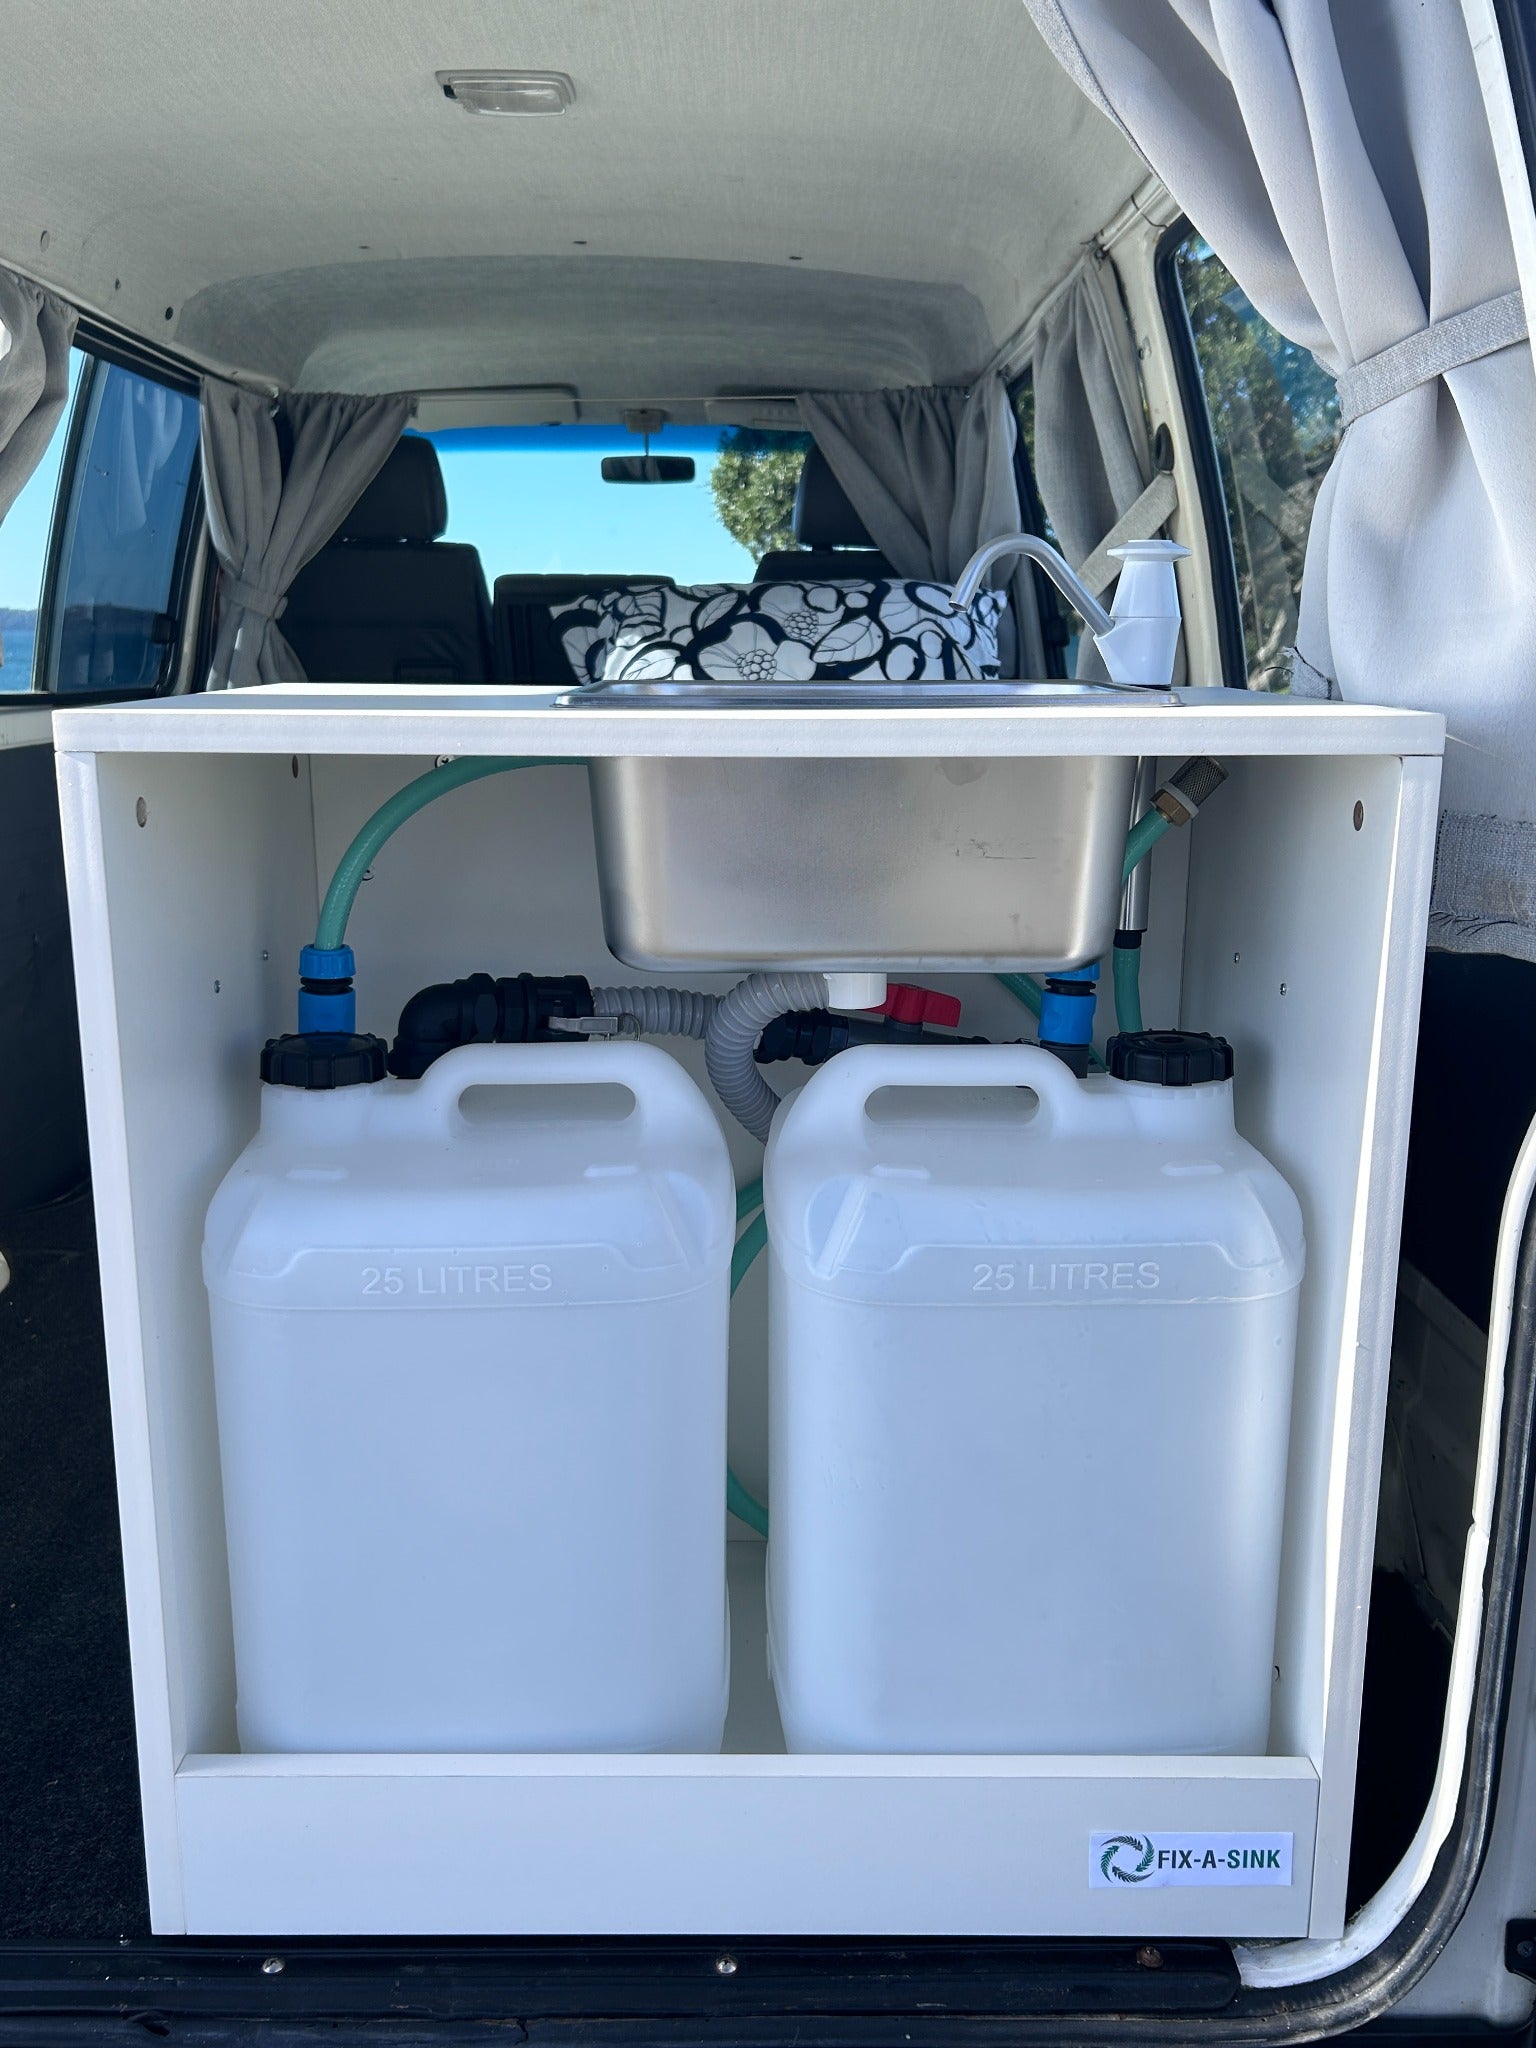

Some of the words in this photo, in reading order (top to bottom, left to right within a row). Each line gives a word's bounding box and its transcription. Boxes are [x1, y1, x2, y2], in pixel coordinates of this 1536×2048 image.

[361, 1267, 403, 1295] 25
[417, 1264, 552, 1294] LITRES
[972, 1263, 1015, 1291] 25
[1027, 1261, 1160, 1290] LITRES
[1158, 1849, 1281, 1869] FIX-A-SINK
